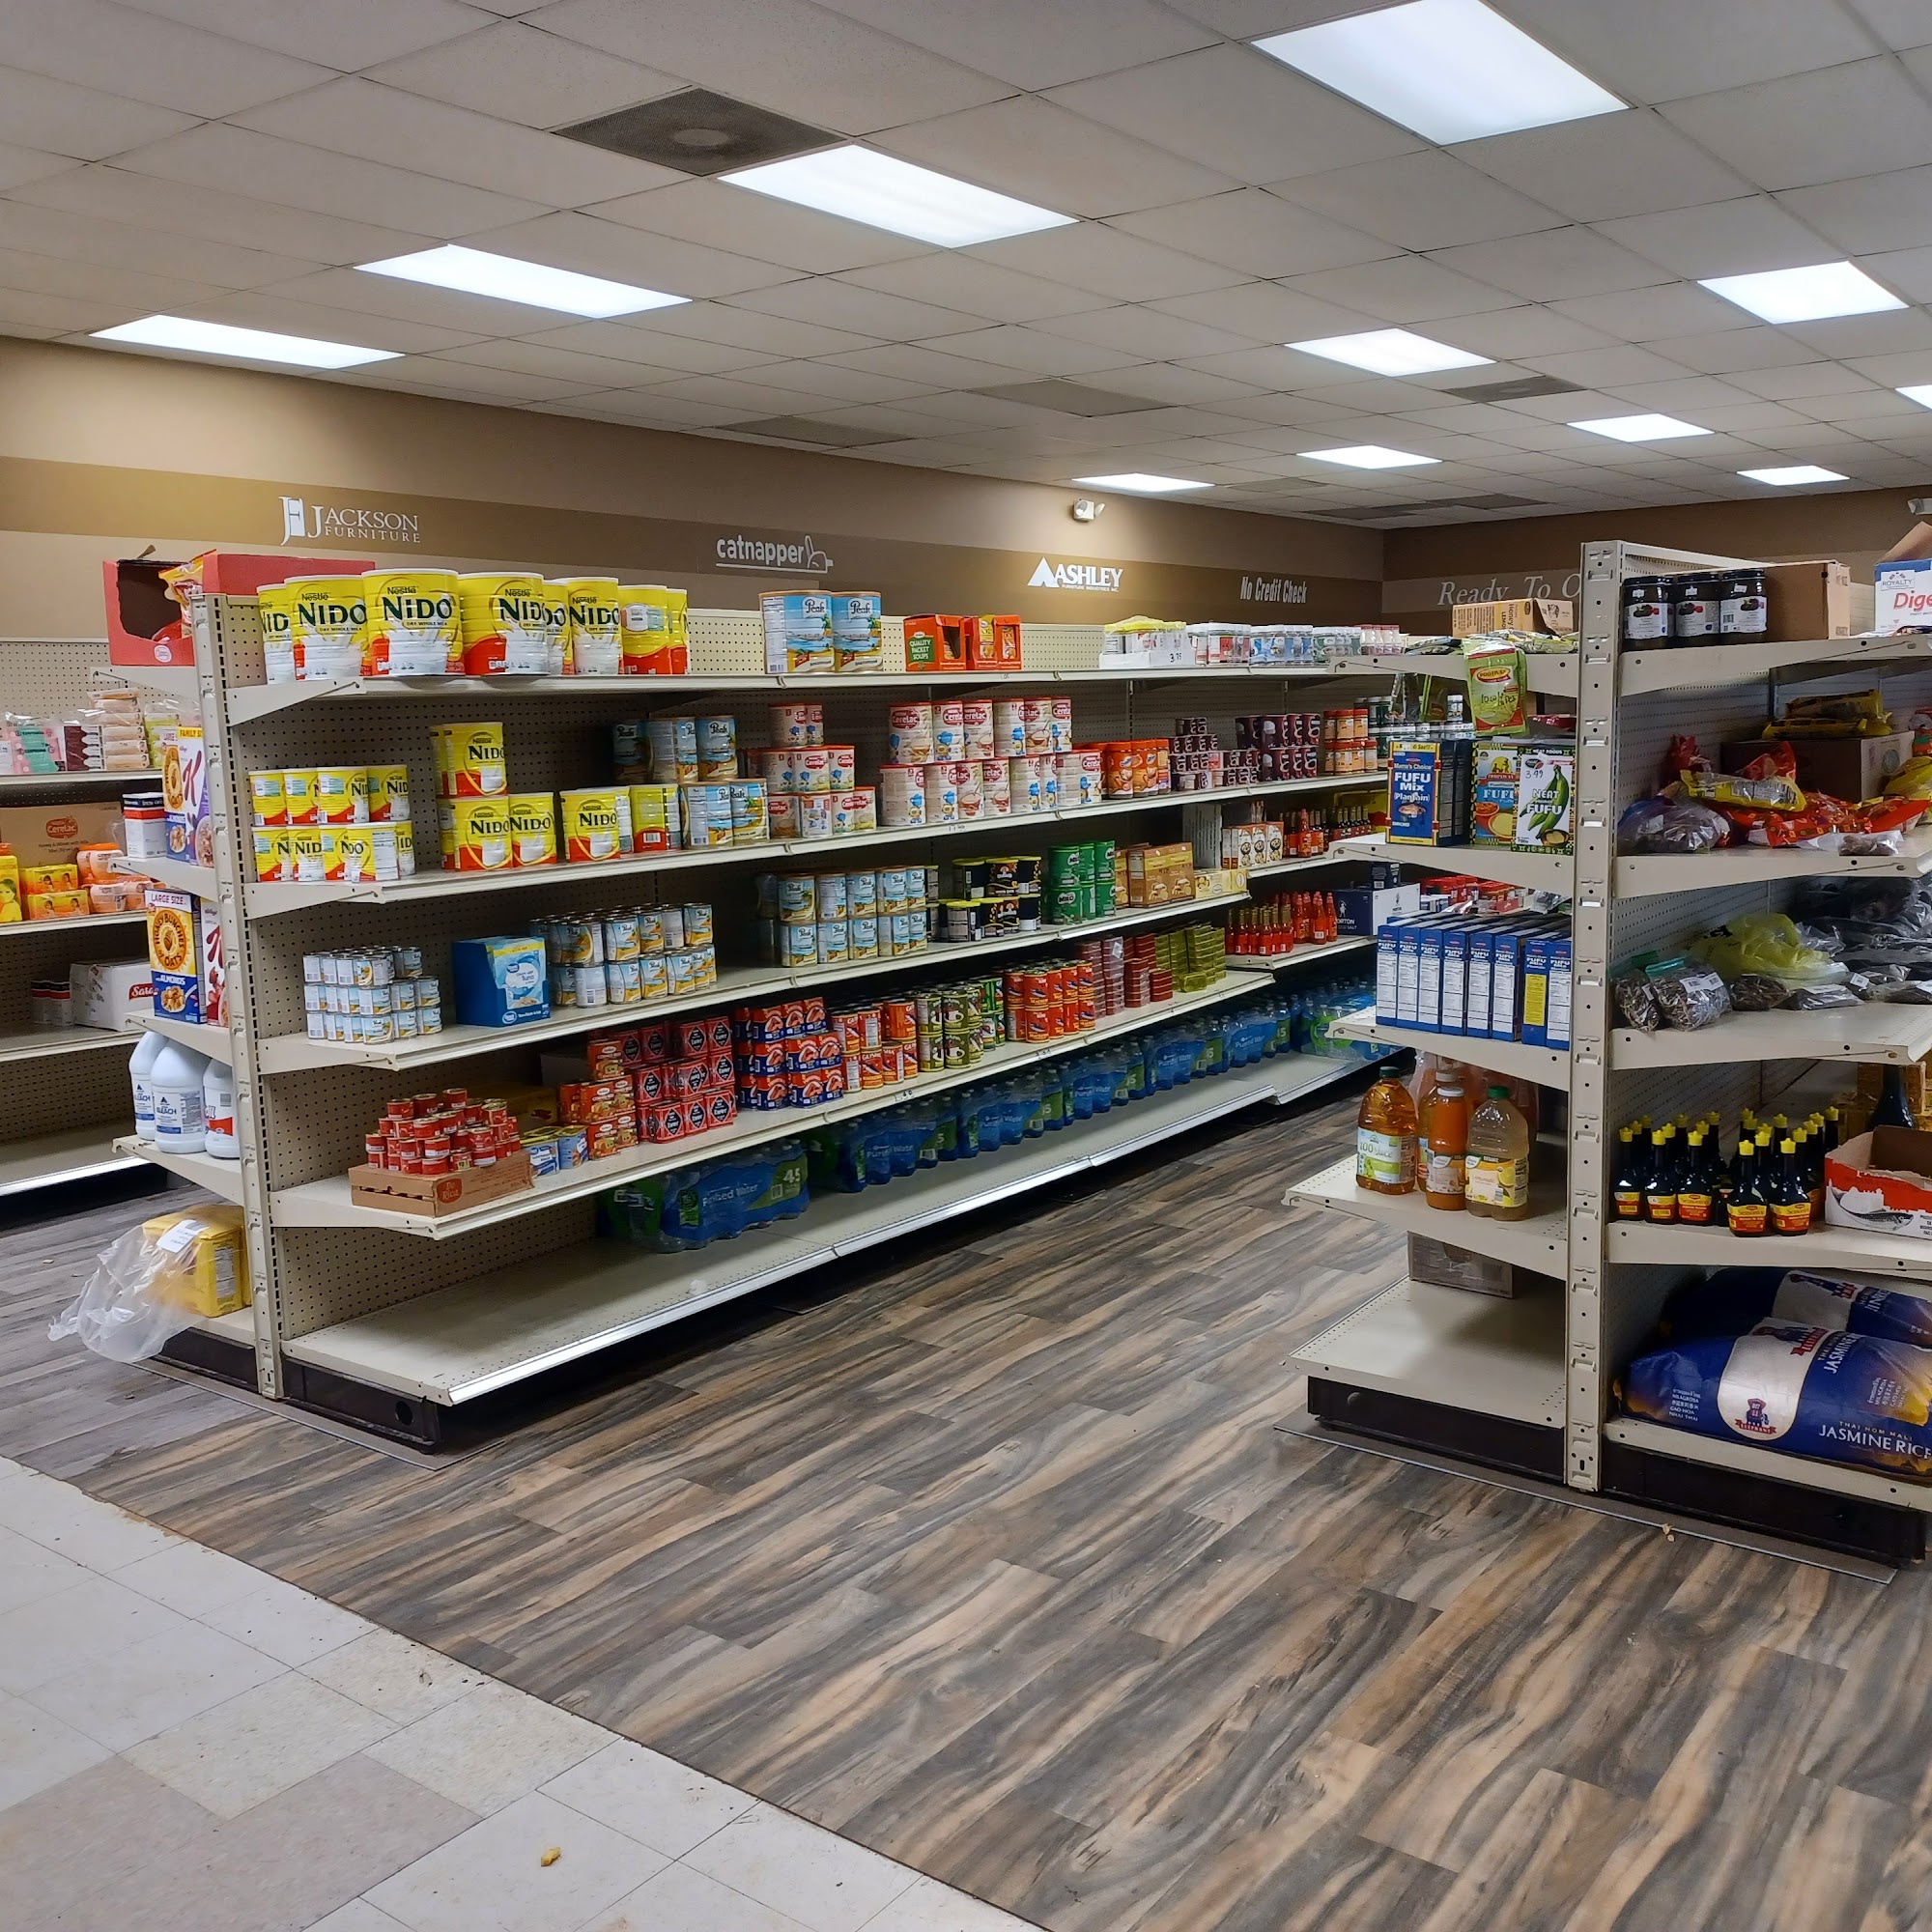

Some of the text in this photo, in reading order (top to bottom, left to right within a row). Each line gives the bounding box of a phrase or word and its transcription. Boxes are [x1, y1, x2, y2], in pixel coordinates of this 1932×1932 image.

[307, 505, 419, 538] JACKSON
[325, 526, 421, 543] FURNITURE
[716, 534, 805, 567] catnapper
[1054, 563, 1123, 587] ASHLEY
[1239, 576, 1308, 604] No Credit Check
[1437, 578, 1510, 606] Ready
[1523, 575, 1551, 599] To
[382, 595, 452, 621] NIDO
[805, 599, 825, 614] Peak
[849, 599, 871, 614] Peak
[298, 602, 366, 627] NIDO
[892, 716, 918, 724] Cerelac
[709, 722, 728, 734] Peak
[1394, 772, 1432, 783] FUFU
[1400, 781, 1424, 791] Mix
[1532, 788, 1560, 799] NEAT
[1526, 804, 1562, 814] FUFU
[509, 816, 552, 831] NIDO
[579, 812, 617, 827] NIDO
[151, 894, 184, 905] LARGE SIZE
[164, 952, 183, 966] OATS
[783, 1167, 801, 1183] 45
[442, 1188, 459, 1200] Rica
[1818, 1425, 1892, 1451] JASMINE
[1839, 1421, 1913, 1441] THAI HOM MALI
